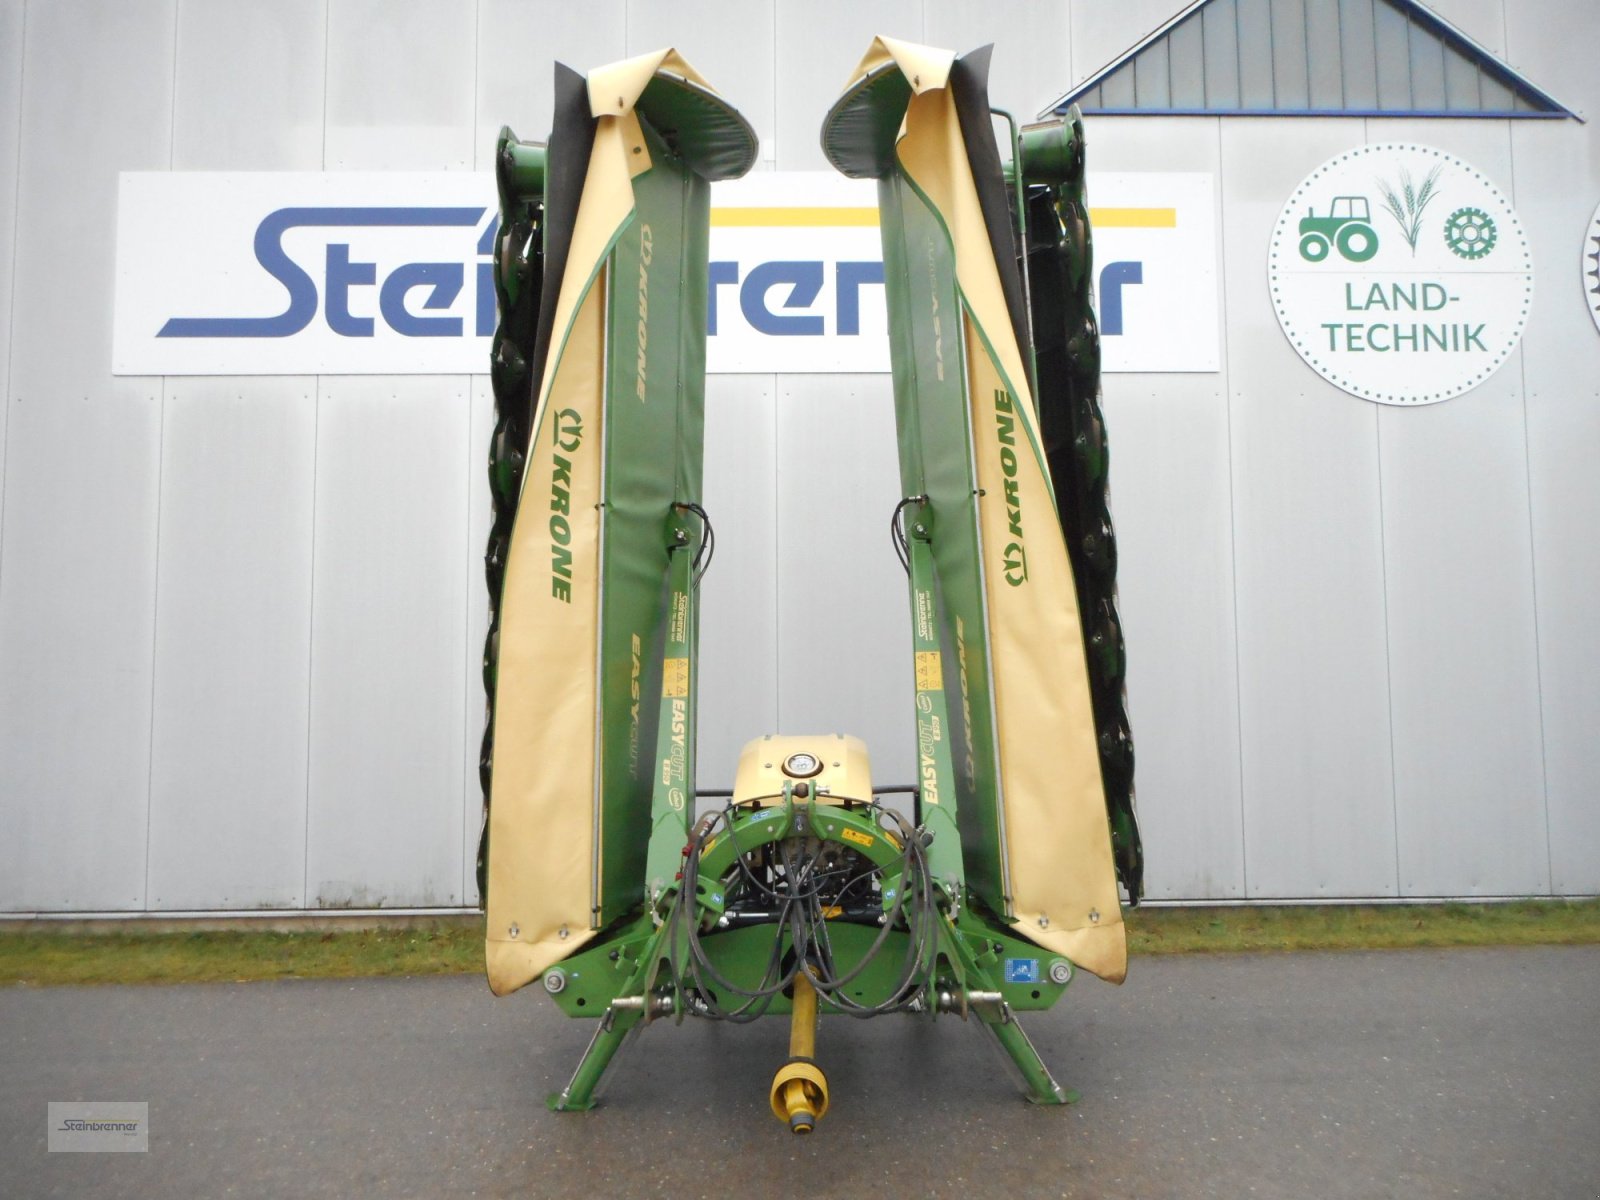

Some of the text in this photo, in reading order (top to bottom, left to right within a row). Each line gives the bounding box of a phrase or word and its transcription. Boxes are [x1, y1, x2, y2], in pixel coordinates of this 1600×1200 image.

[637, 266, 653, 404] KRONE
[1321, 323, 1488, 353] TECHNIK
[1345, 282, 1460, 311] LAND-
[994, 388, 1024, 539] KRONE
[548, 453, 573, 605] KRONE
[671, 699, 686, 781] EASYCUT
[956, 615, 973, 753] KRONE
[919, 719, 939, 805] EASYCUT
